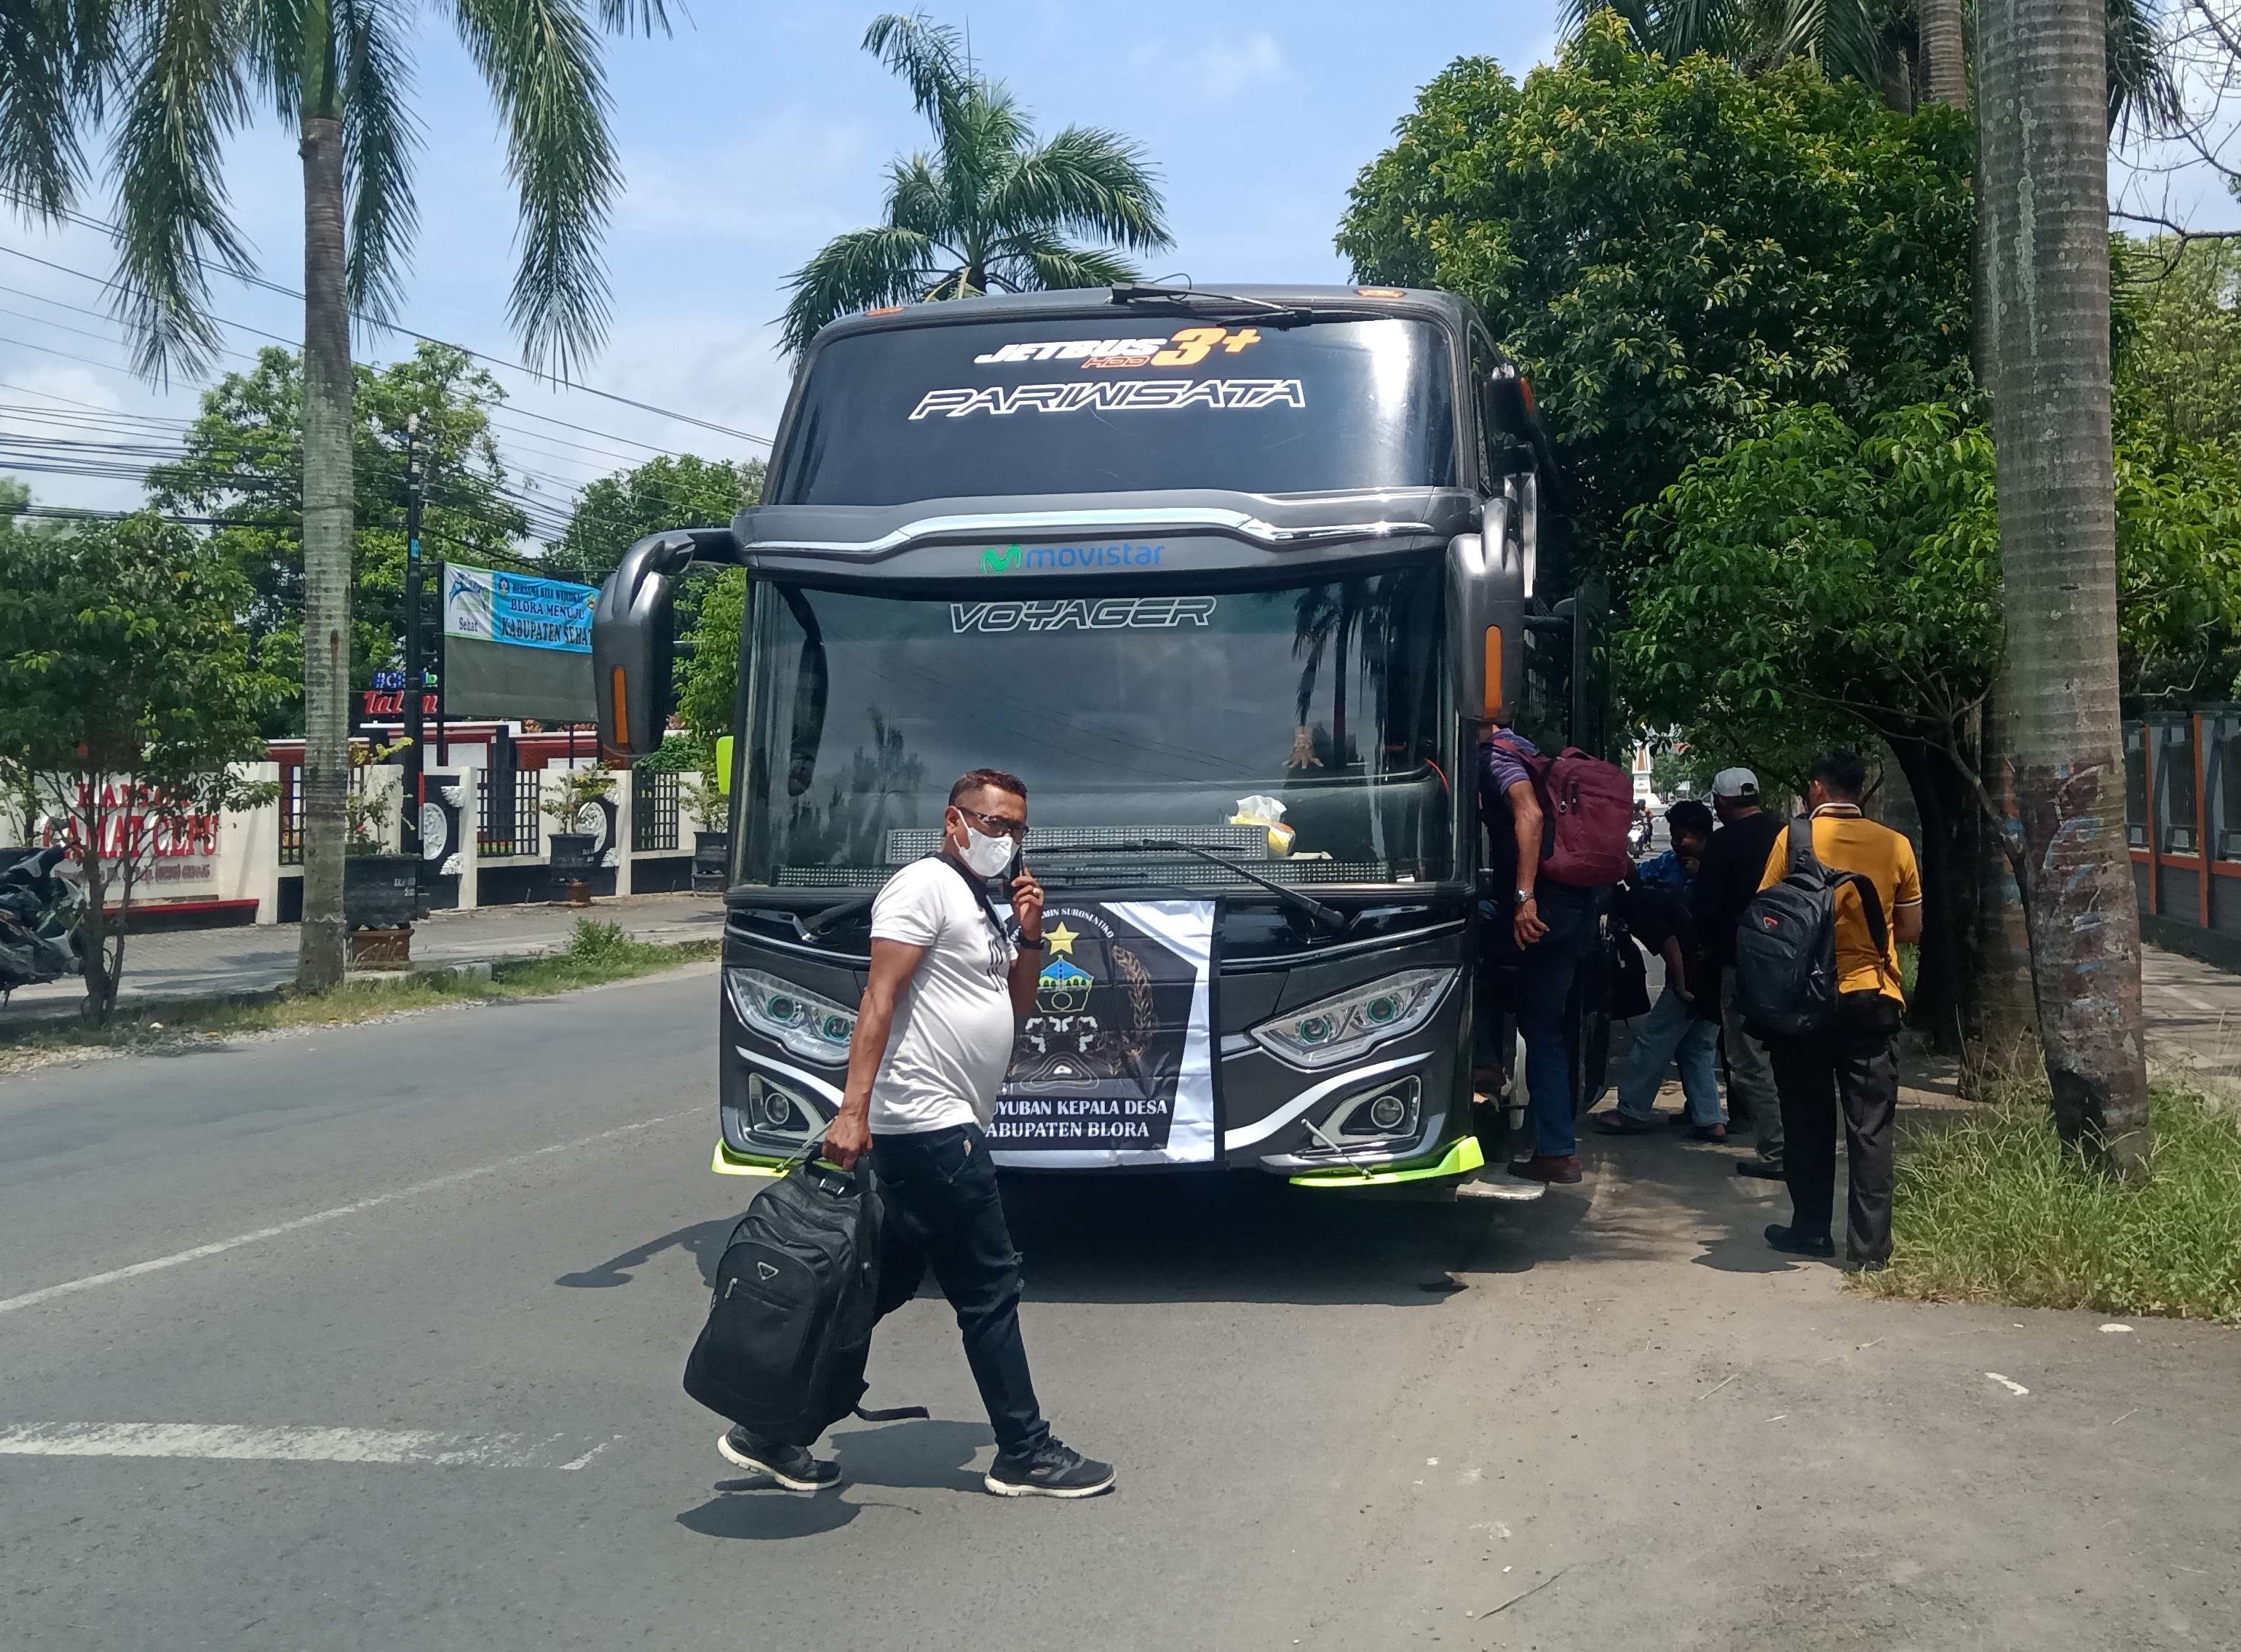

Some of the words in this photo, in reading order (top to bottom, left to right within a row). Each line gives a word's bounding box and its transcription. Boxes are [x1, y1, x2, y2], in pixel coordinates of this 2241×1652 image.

[974, 338, 1168, 364] JETBUS
[908, 379, 1306, 420] PARIWISATA
[1026, 543, 1165, 568] movistar
[511, 598, 544, 615] BLORA
[546, 604, 585, 620] MENUJU
[950, 595, 1217, 633] VOYAGER
[459, 616, 478, 632] Sehat
[501, 616, 562, 642] KABUPATEN
[1041, 908, 1060, 919] MIN
[1057, 1100, 1120, 1115] KEPALA
[1125, 1100, 1168, 1115] DESA
[985, 1121, 1082, 1138] ABUPATEN
[1087, 1121, 1150, 1137] BLORA
